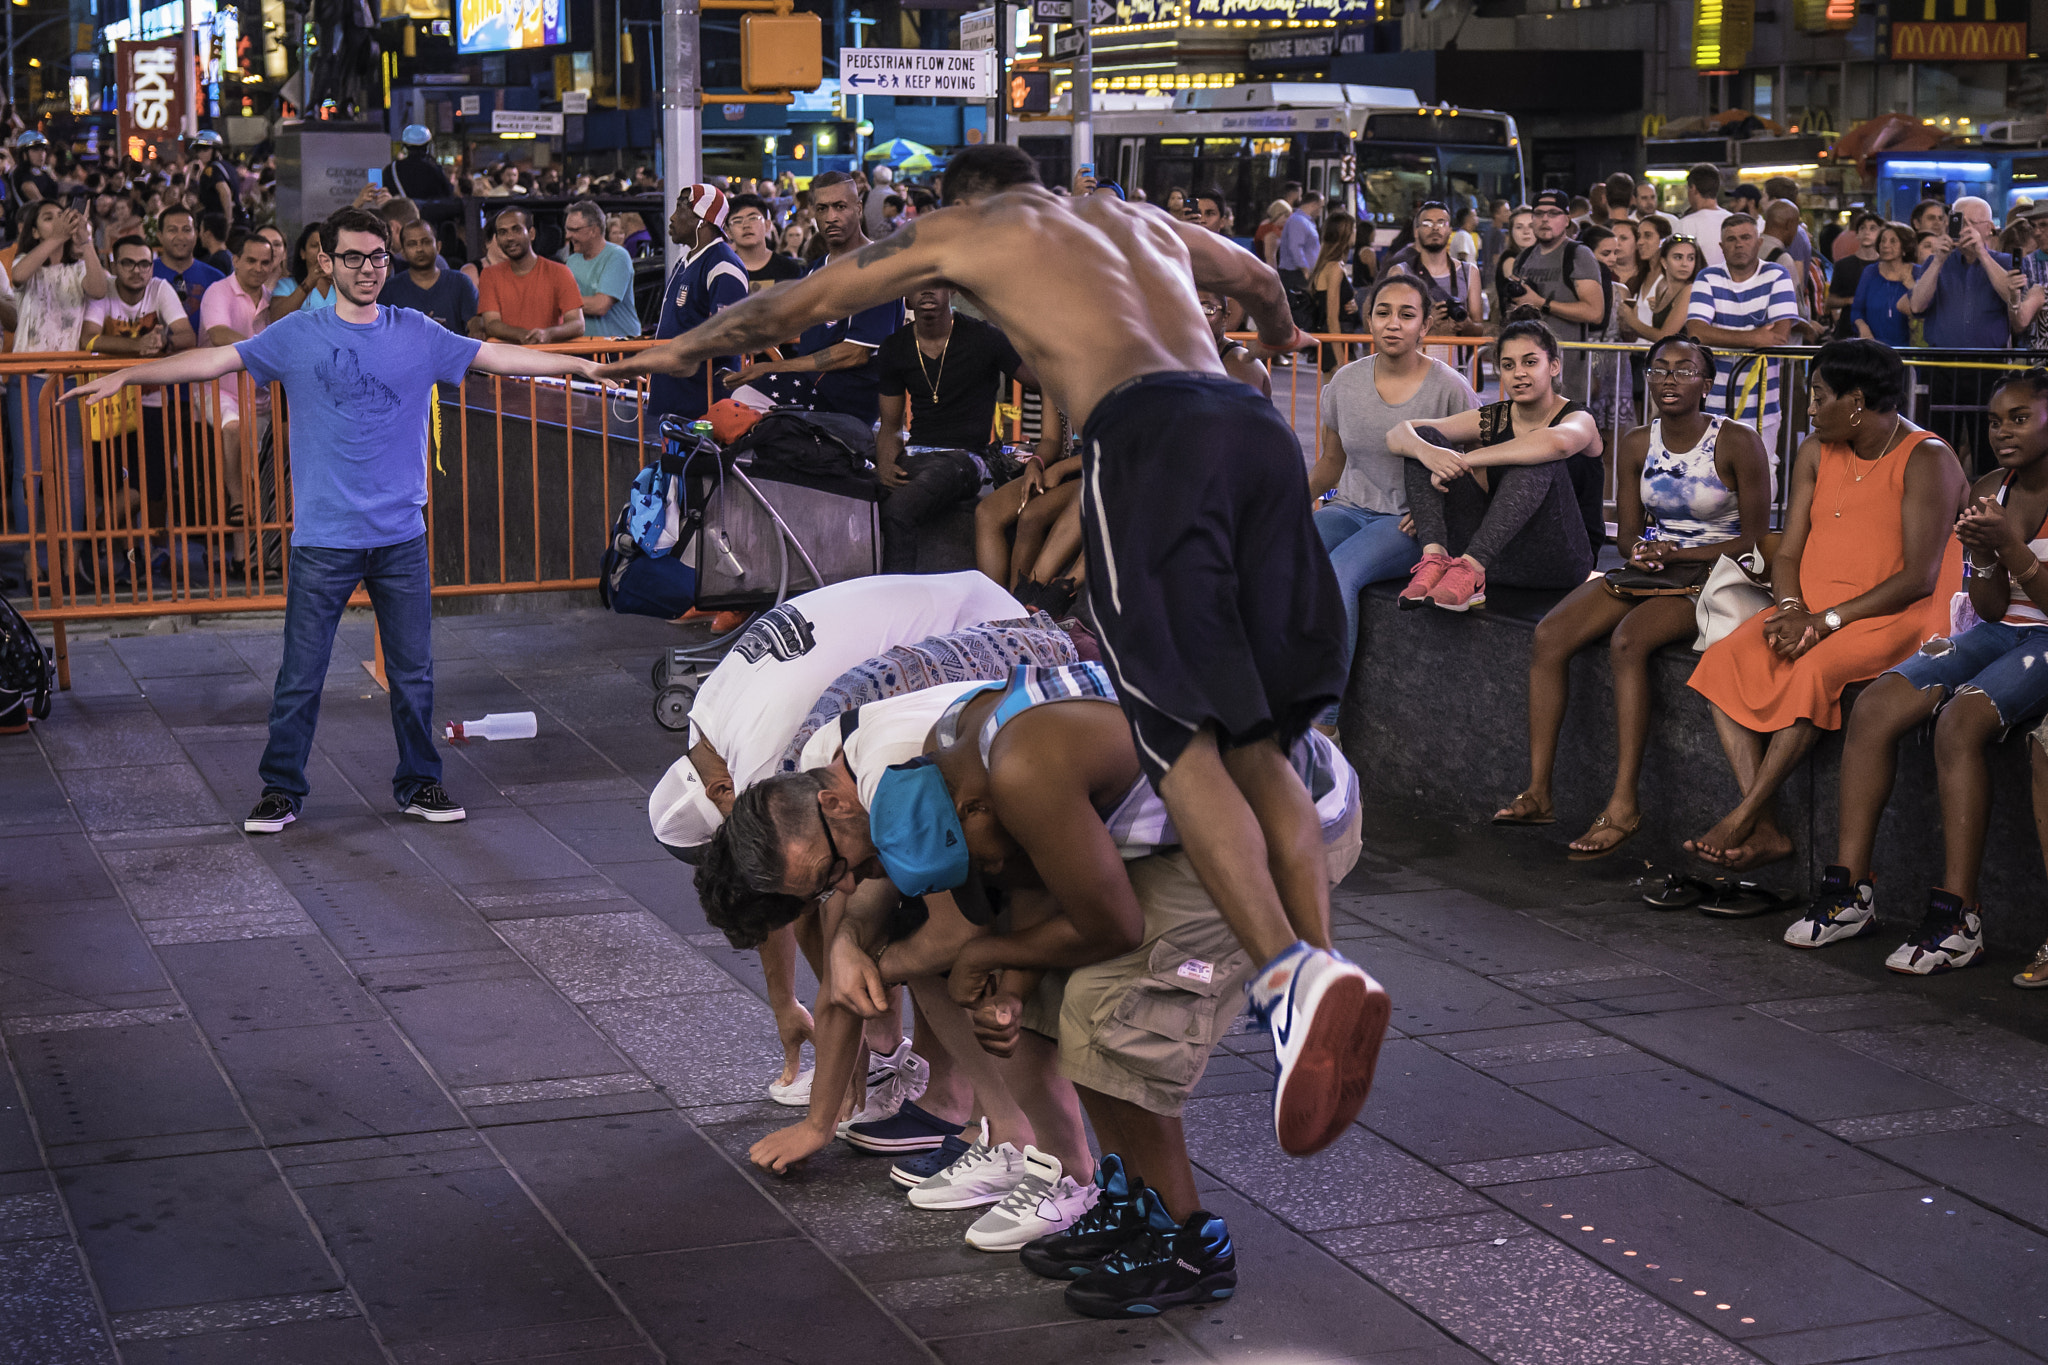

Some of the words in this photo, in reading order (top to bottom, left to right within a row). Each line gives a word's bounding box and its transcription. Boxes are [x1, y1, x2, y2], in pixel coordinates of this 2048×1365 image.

[1041, 3, 1066, 15] ONE
[1249, 40, 1293, 60] CHANGE
[1295, 37, 1334, 57] MONEY
[1340, 35, 1364, 53] ATM
[847, 54, 913, 69] PEDESTRIAN
[916, 56, 945, 70] FLOW
[948, 57, 976, 71] ZONE
[133, 46, 175, 129] tkts
[905, 75, 931, 89] KEEP
[935, 75, 976, 90] MOVING
[1177, 1258, 1201, 1275] Reebok
